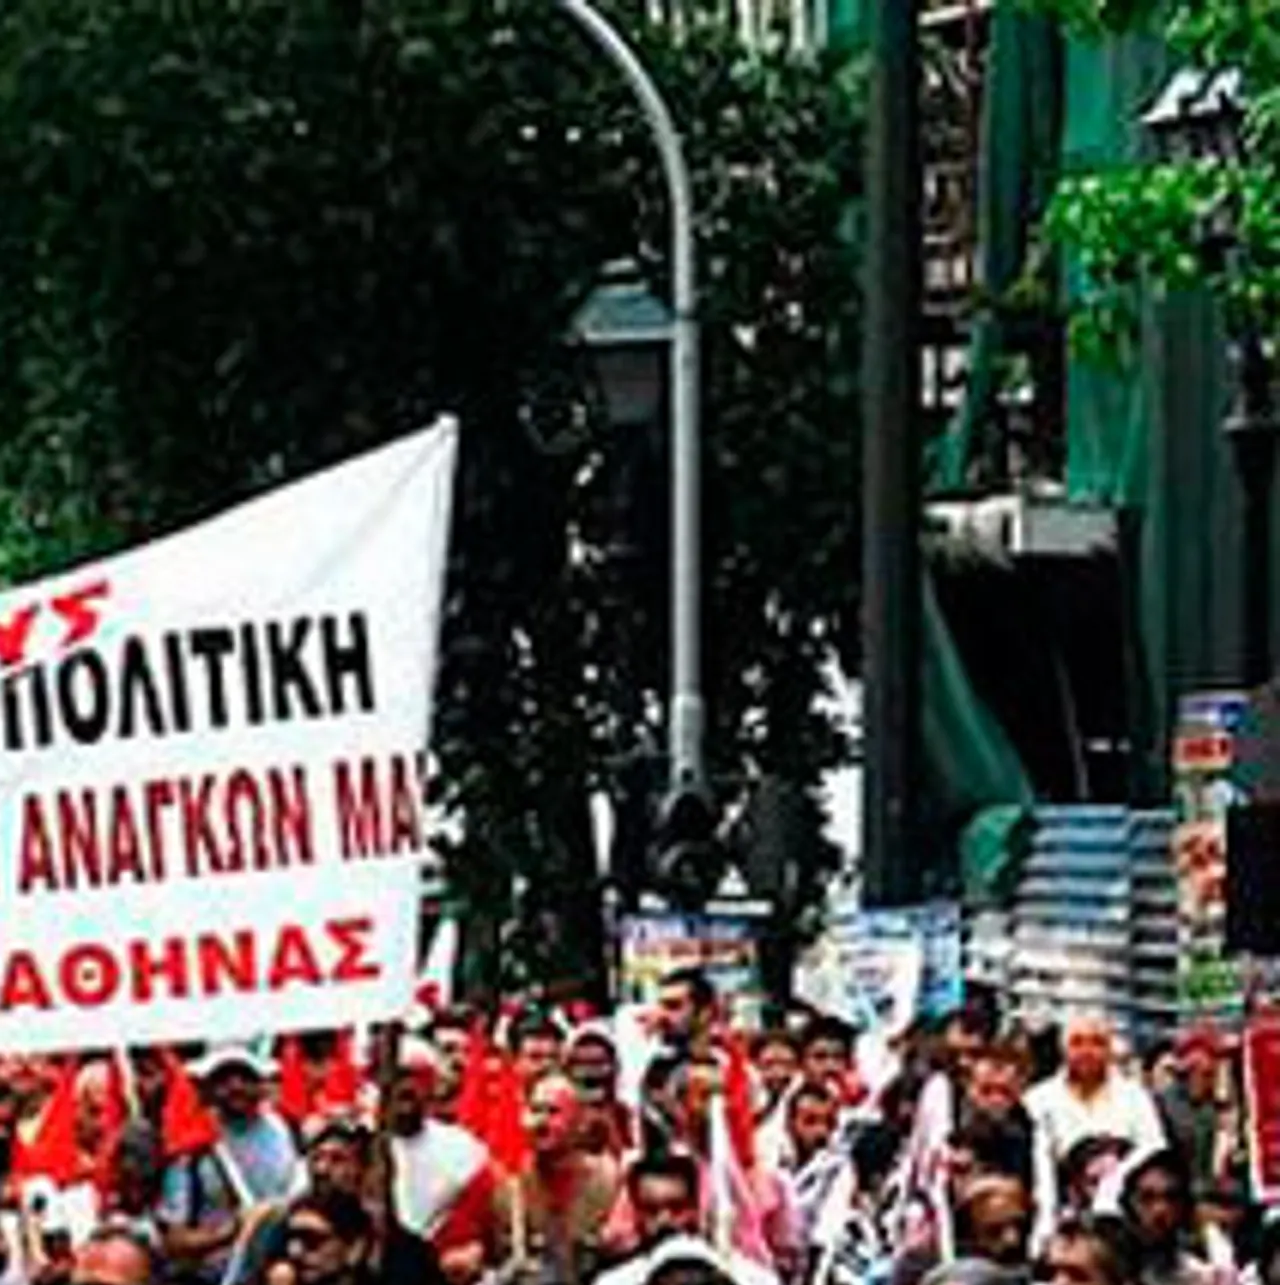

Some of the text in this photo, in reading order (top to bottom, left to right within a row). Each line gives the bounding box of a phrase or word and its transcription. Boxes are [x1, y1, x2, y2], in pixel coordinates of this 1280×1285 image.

[2, 612, 375, 750] ΠΟΛΙΤΙΚΗ
[18, 762, 317, 896] ΑΝΑΓΚΩΝ
[333, 748, 428, 862] ΜΑ
